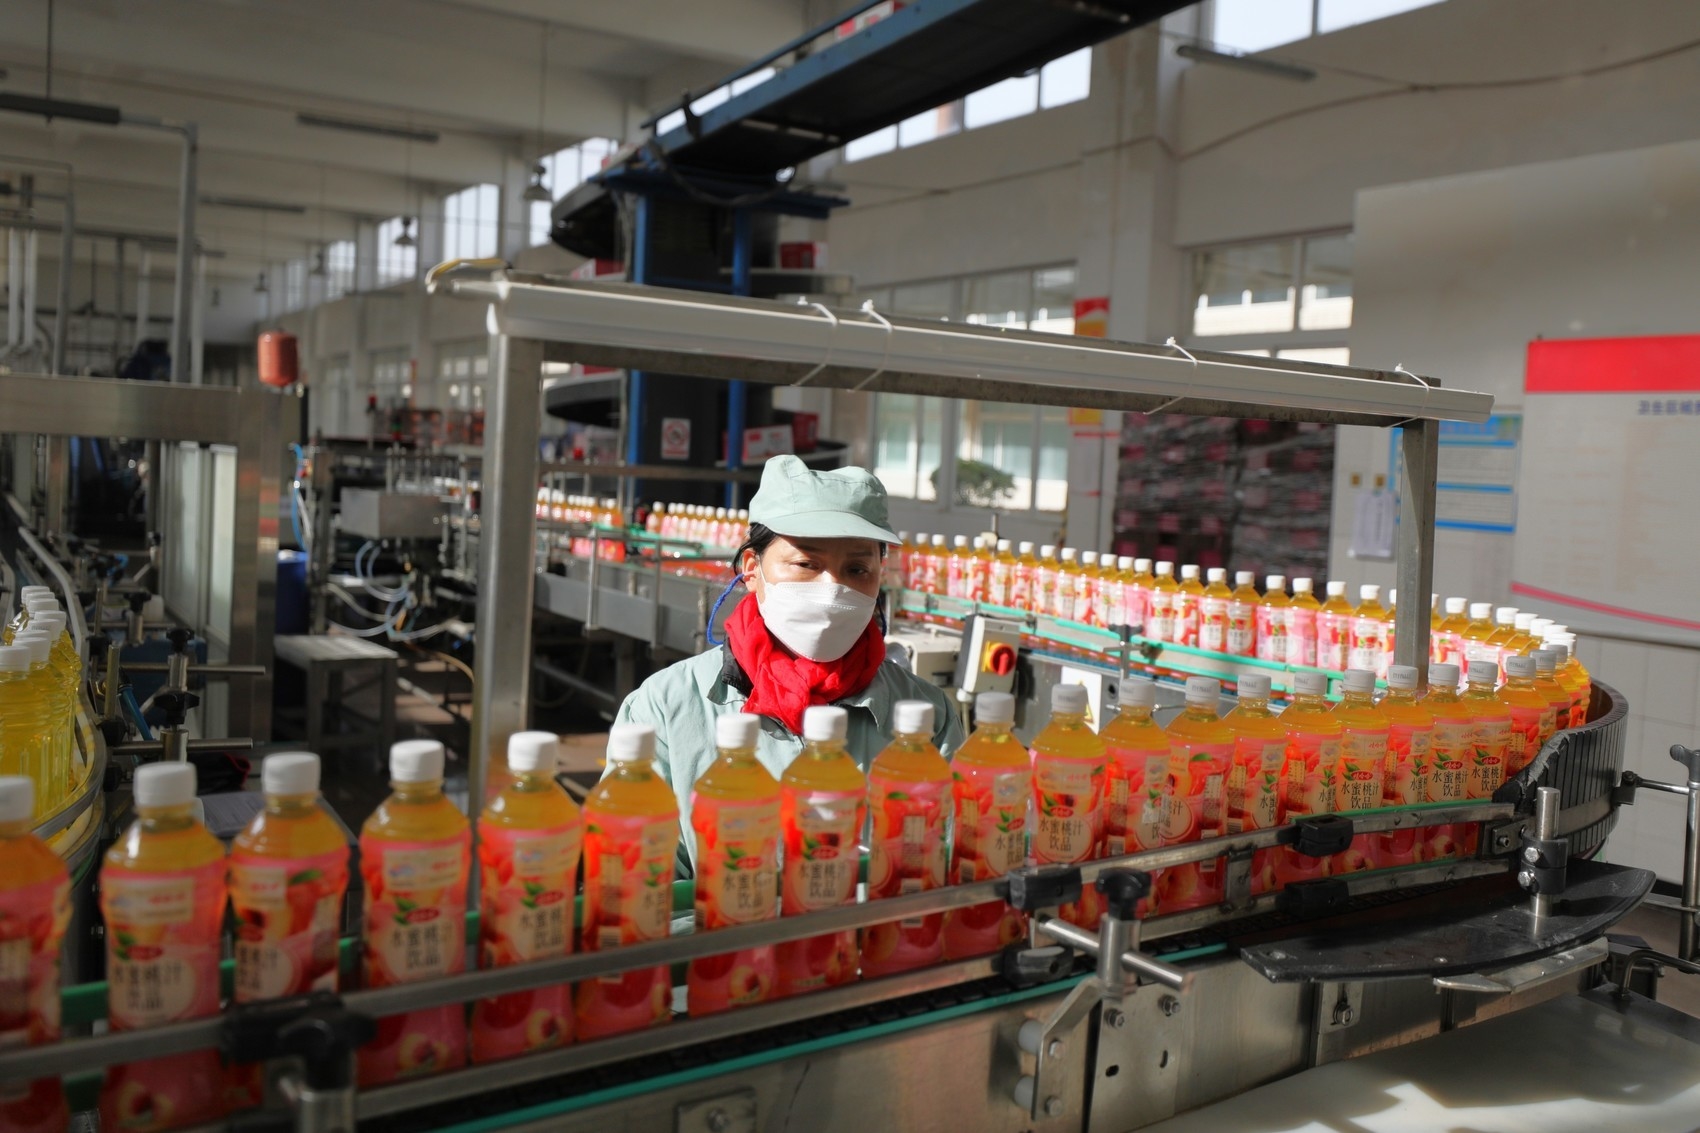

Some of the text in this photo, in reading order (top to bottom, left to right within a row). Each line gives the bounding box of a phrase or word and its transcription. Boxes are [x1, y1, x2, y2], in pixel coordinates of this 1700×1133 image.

[1432, 770, 1468, 783] 水蜜桃汁
[1341, 782, 1379, 795] 水蜜桃汁
[1442, 784, 1461, 797] 饮品
[1351, 796, 1372, 809] 饮品
[1040, 818, 1083, 836] 水蜜桃汁
[1050, 835, 1072, 852] 饮品
